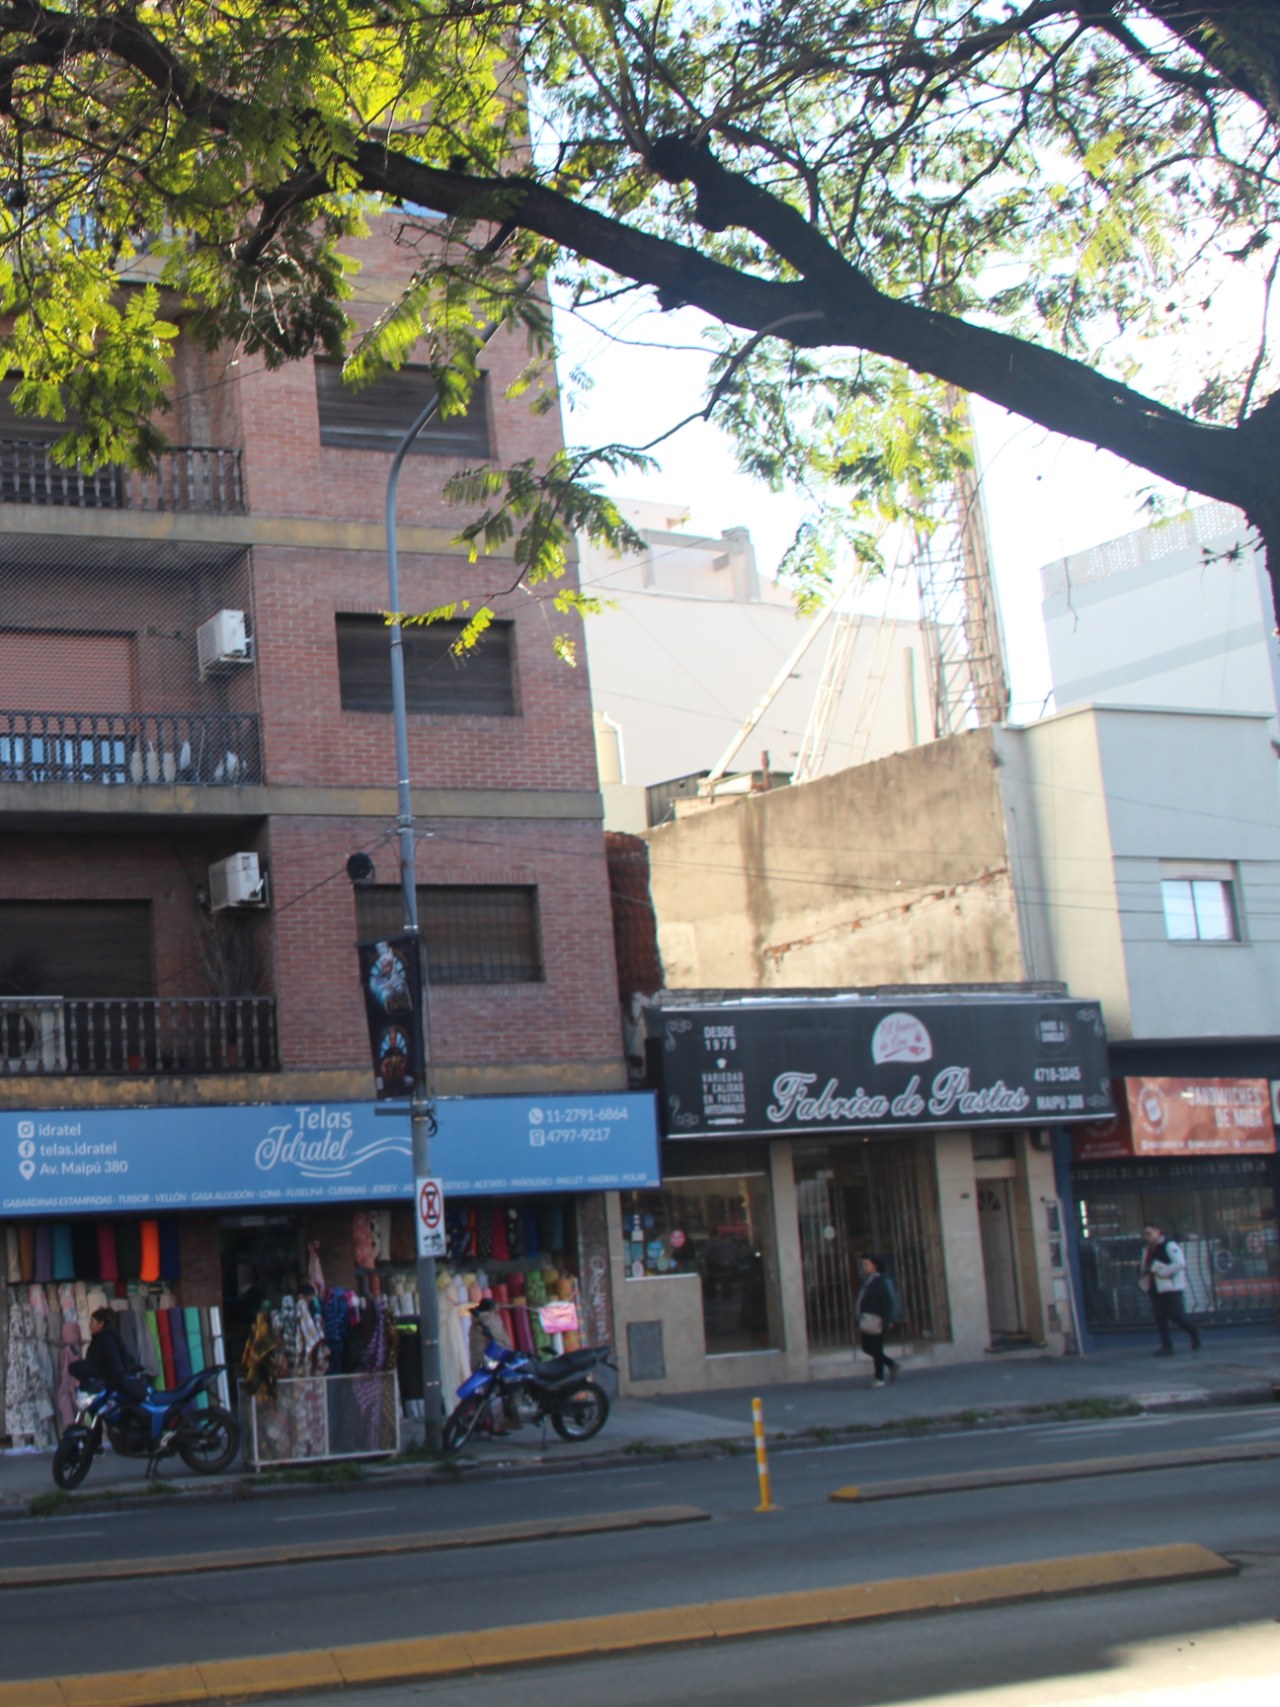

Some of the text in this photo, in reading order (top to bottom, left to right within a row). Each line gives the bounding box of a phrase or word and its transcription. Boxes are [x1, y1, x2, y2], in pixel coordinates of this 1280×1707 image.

[703, 1026, 736, 1038] DESDE
[705, 1039, 736, 1050] 1979
[702, 1072, 744, 1083] VARIEDAD
[767, 1066, 1030, 1122] Fabrica de Pastas
[295, 1106, 353, 1130] Telas
[547, 1107, 628, 1123] 11-2791-6864
[38, 1122, 81, 1137] idratel
[547, 1127, 611, 1142] 4797-9217
[40, 1141, 117, 1156] telas.idratel
[40, 1160, 129, 1177] Av. Maipú 380
[3, 1197, 58, 1209] GABARDINAS
[59, 1194, 113, 1207] ESTAMPADAS
